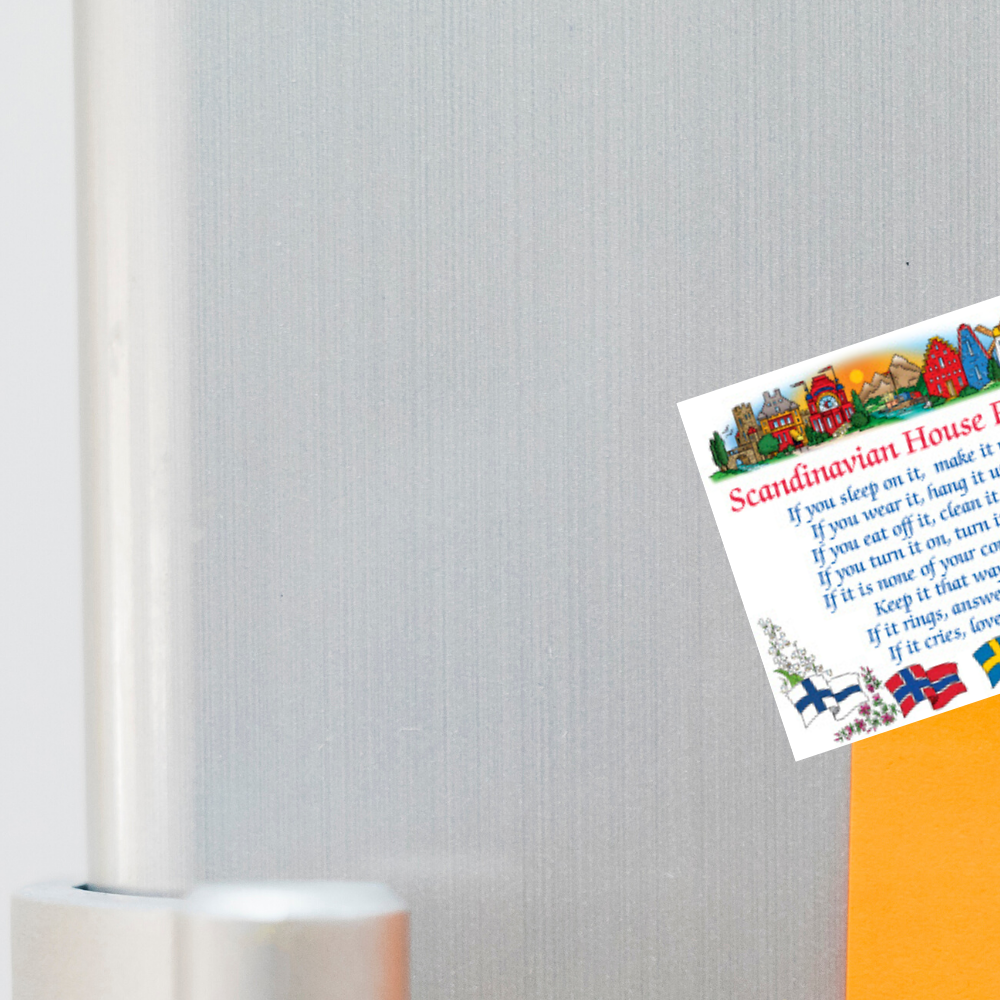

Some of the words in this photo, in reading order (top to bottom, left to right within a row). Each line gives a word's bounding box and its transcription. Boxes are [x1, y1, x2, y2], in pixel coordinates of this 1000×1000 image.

[728, 442, 901, 513] Scandinavian
[901, 413, 986, 455] House
[787, 502, 802, 528] If
[804, 497, 837, 524] you
[839, 482, 879, 506] sleep
[882, 474, 905, 491] on
[906, 467, 926, 483] it,
[933, 448, 975, 474] make
[979, 443, 994, 459] it
[810, 519, 826, 545] If
[827, 514, 860, 541] you
[861, 499, 903, 522] wear
[905, 492, 925, 508] it,
[926, 477, 969, 500] hang
[970, 470, 986, 486] it
[811, 543, 826, 569] If
[828, 538, 861, 565] you
[862, 527, 889, 547] eat
[891, 514, 914, 541] off
[916, 513, 936, 528] it,
[939, 498, 983, 522] clean
[984, 490, 1000, 506] it
[817, 566, 832, 592] If
[834, 561, 867, 588] you
[868, 548, 906, 569] turn
[907, 540, 923, 556] it
[925, 534, 952, 550] on,
[954, 519, 991, 541] turn
[822, 588, 838, 614] If
[840, 587, 856, 603] it
[857, 582, 874, 597] is
[876, 568, 915, 591] none
[920, 556, 936, 581] of
[938, 548, 976, 578] your
[866, 623, 882, 649] If
[884, 622, 900, 638] it
[902, 609, 949, 631] rings,
[873, 594, 913, 617] Keep
[916, 587, 932, 603] it
[934, 574, 969, 597] that
[888, 641, 903, 666] If
[906, 640, 921, 655] it
[924, 627, 967, 650] cries,
